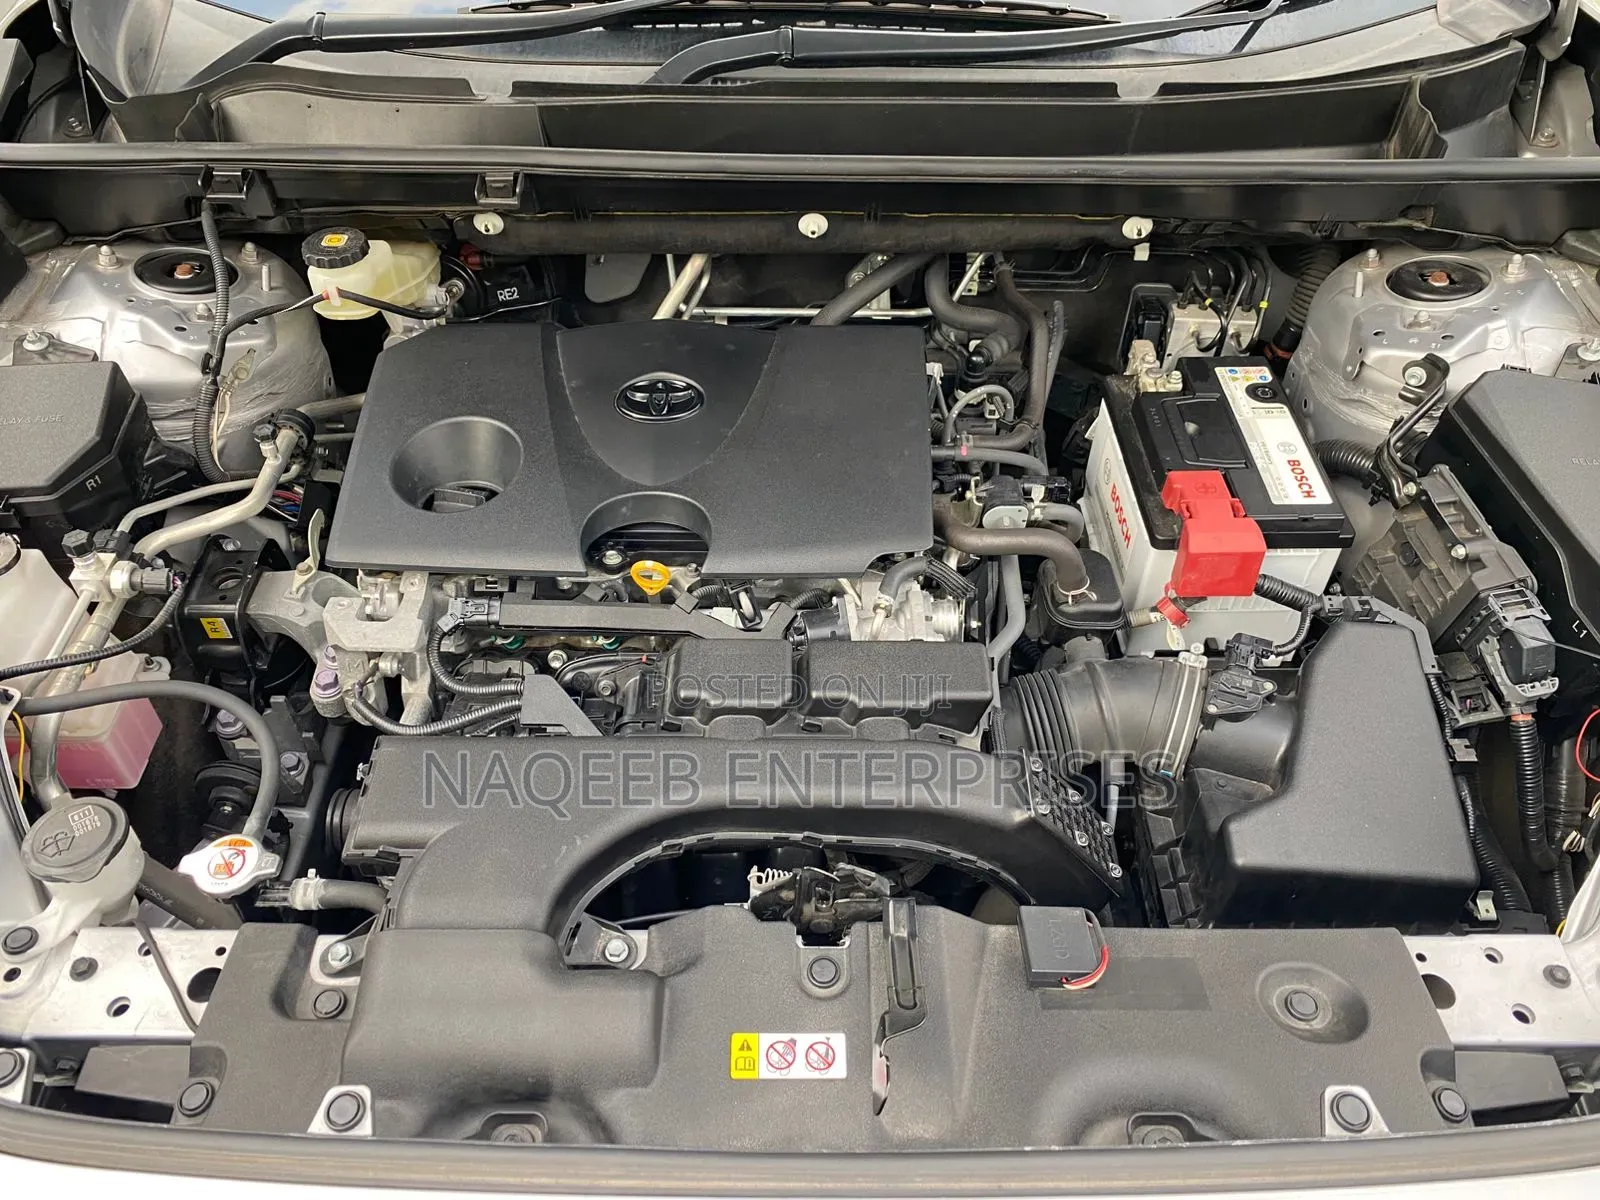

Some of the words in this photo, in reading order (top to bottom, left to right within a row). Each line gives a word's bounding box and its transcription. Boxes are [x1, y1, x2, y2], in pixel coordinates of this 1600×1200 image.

[496, 286, 520, 302] RE2
[85, 474, 102, 491] R1
[1287, 459, 1317, 499] BOSCH
[1110, 482, 1132, 550] BOSCH
[1571, 619, 1588, 639] L1
